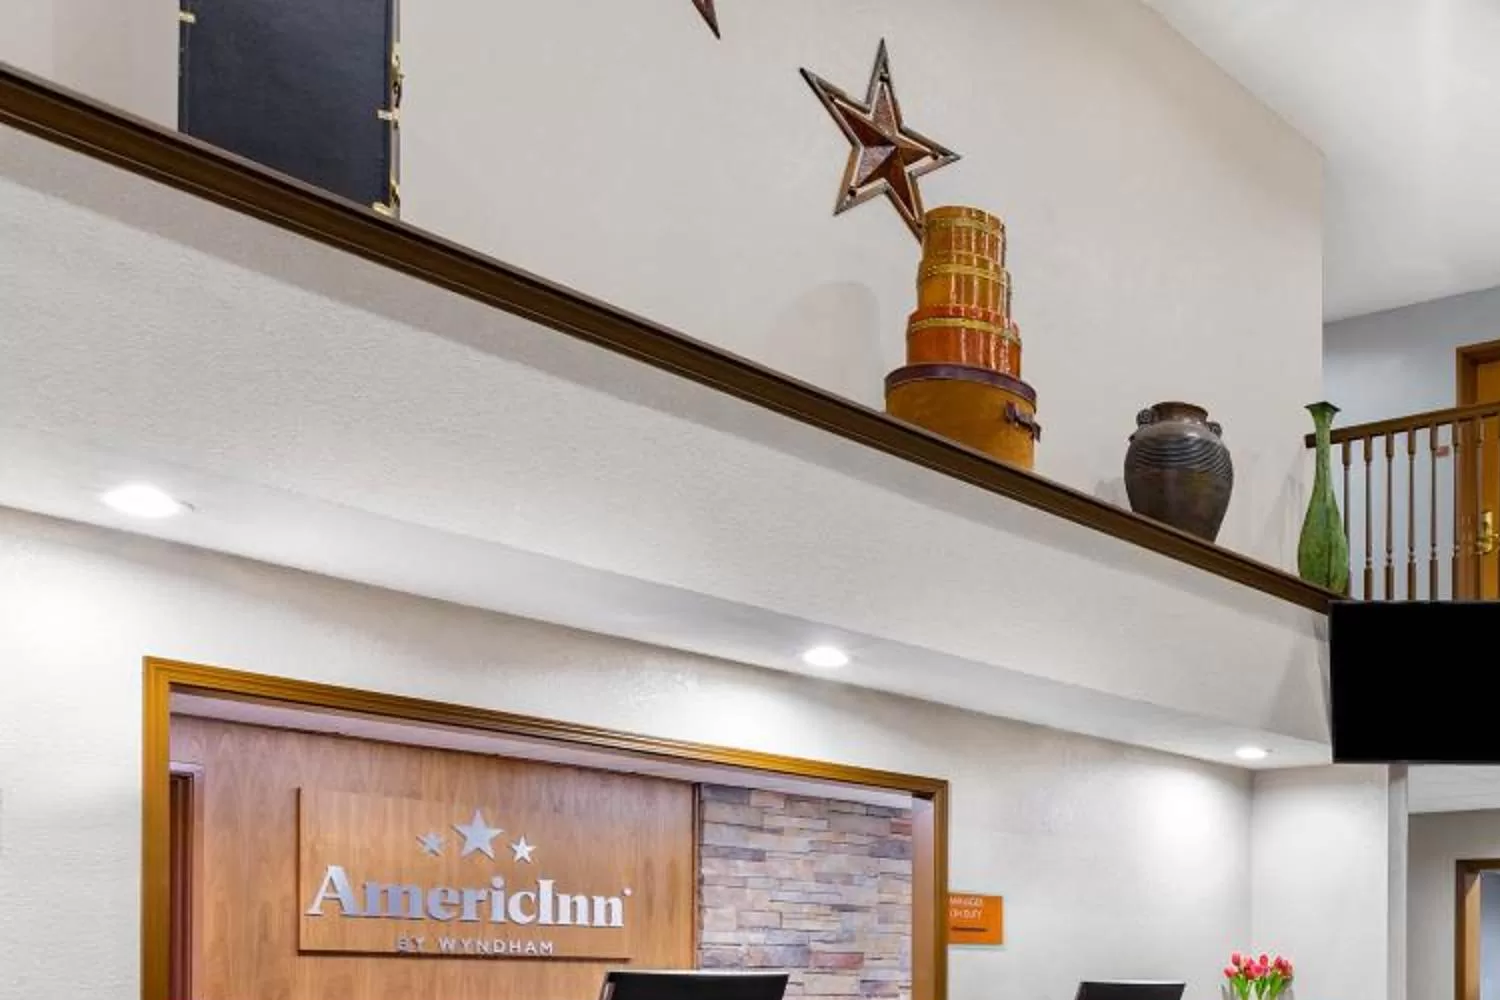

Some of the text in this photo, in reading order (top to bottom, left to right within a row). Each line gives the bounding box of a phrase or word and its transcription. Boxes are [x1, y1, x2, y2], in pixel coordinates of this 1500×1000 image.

[304, 864, 625, 928] AmericInn
[398, 935, 554, 955] BY WYNDHAM
